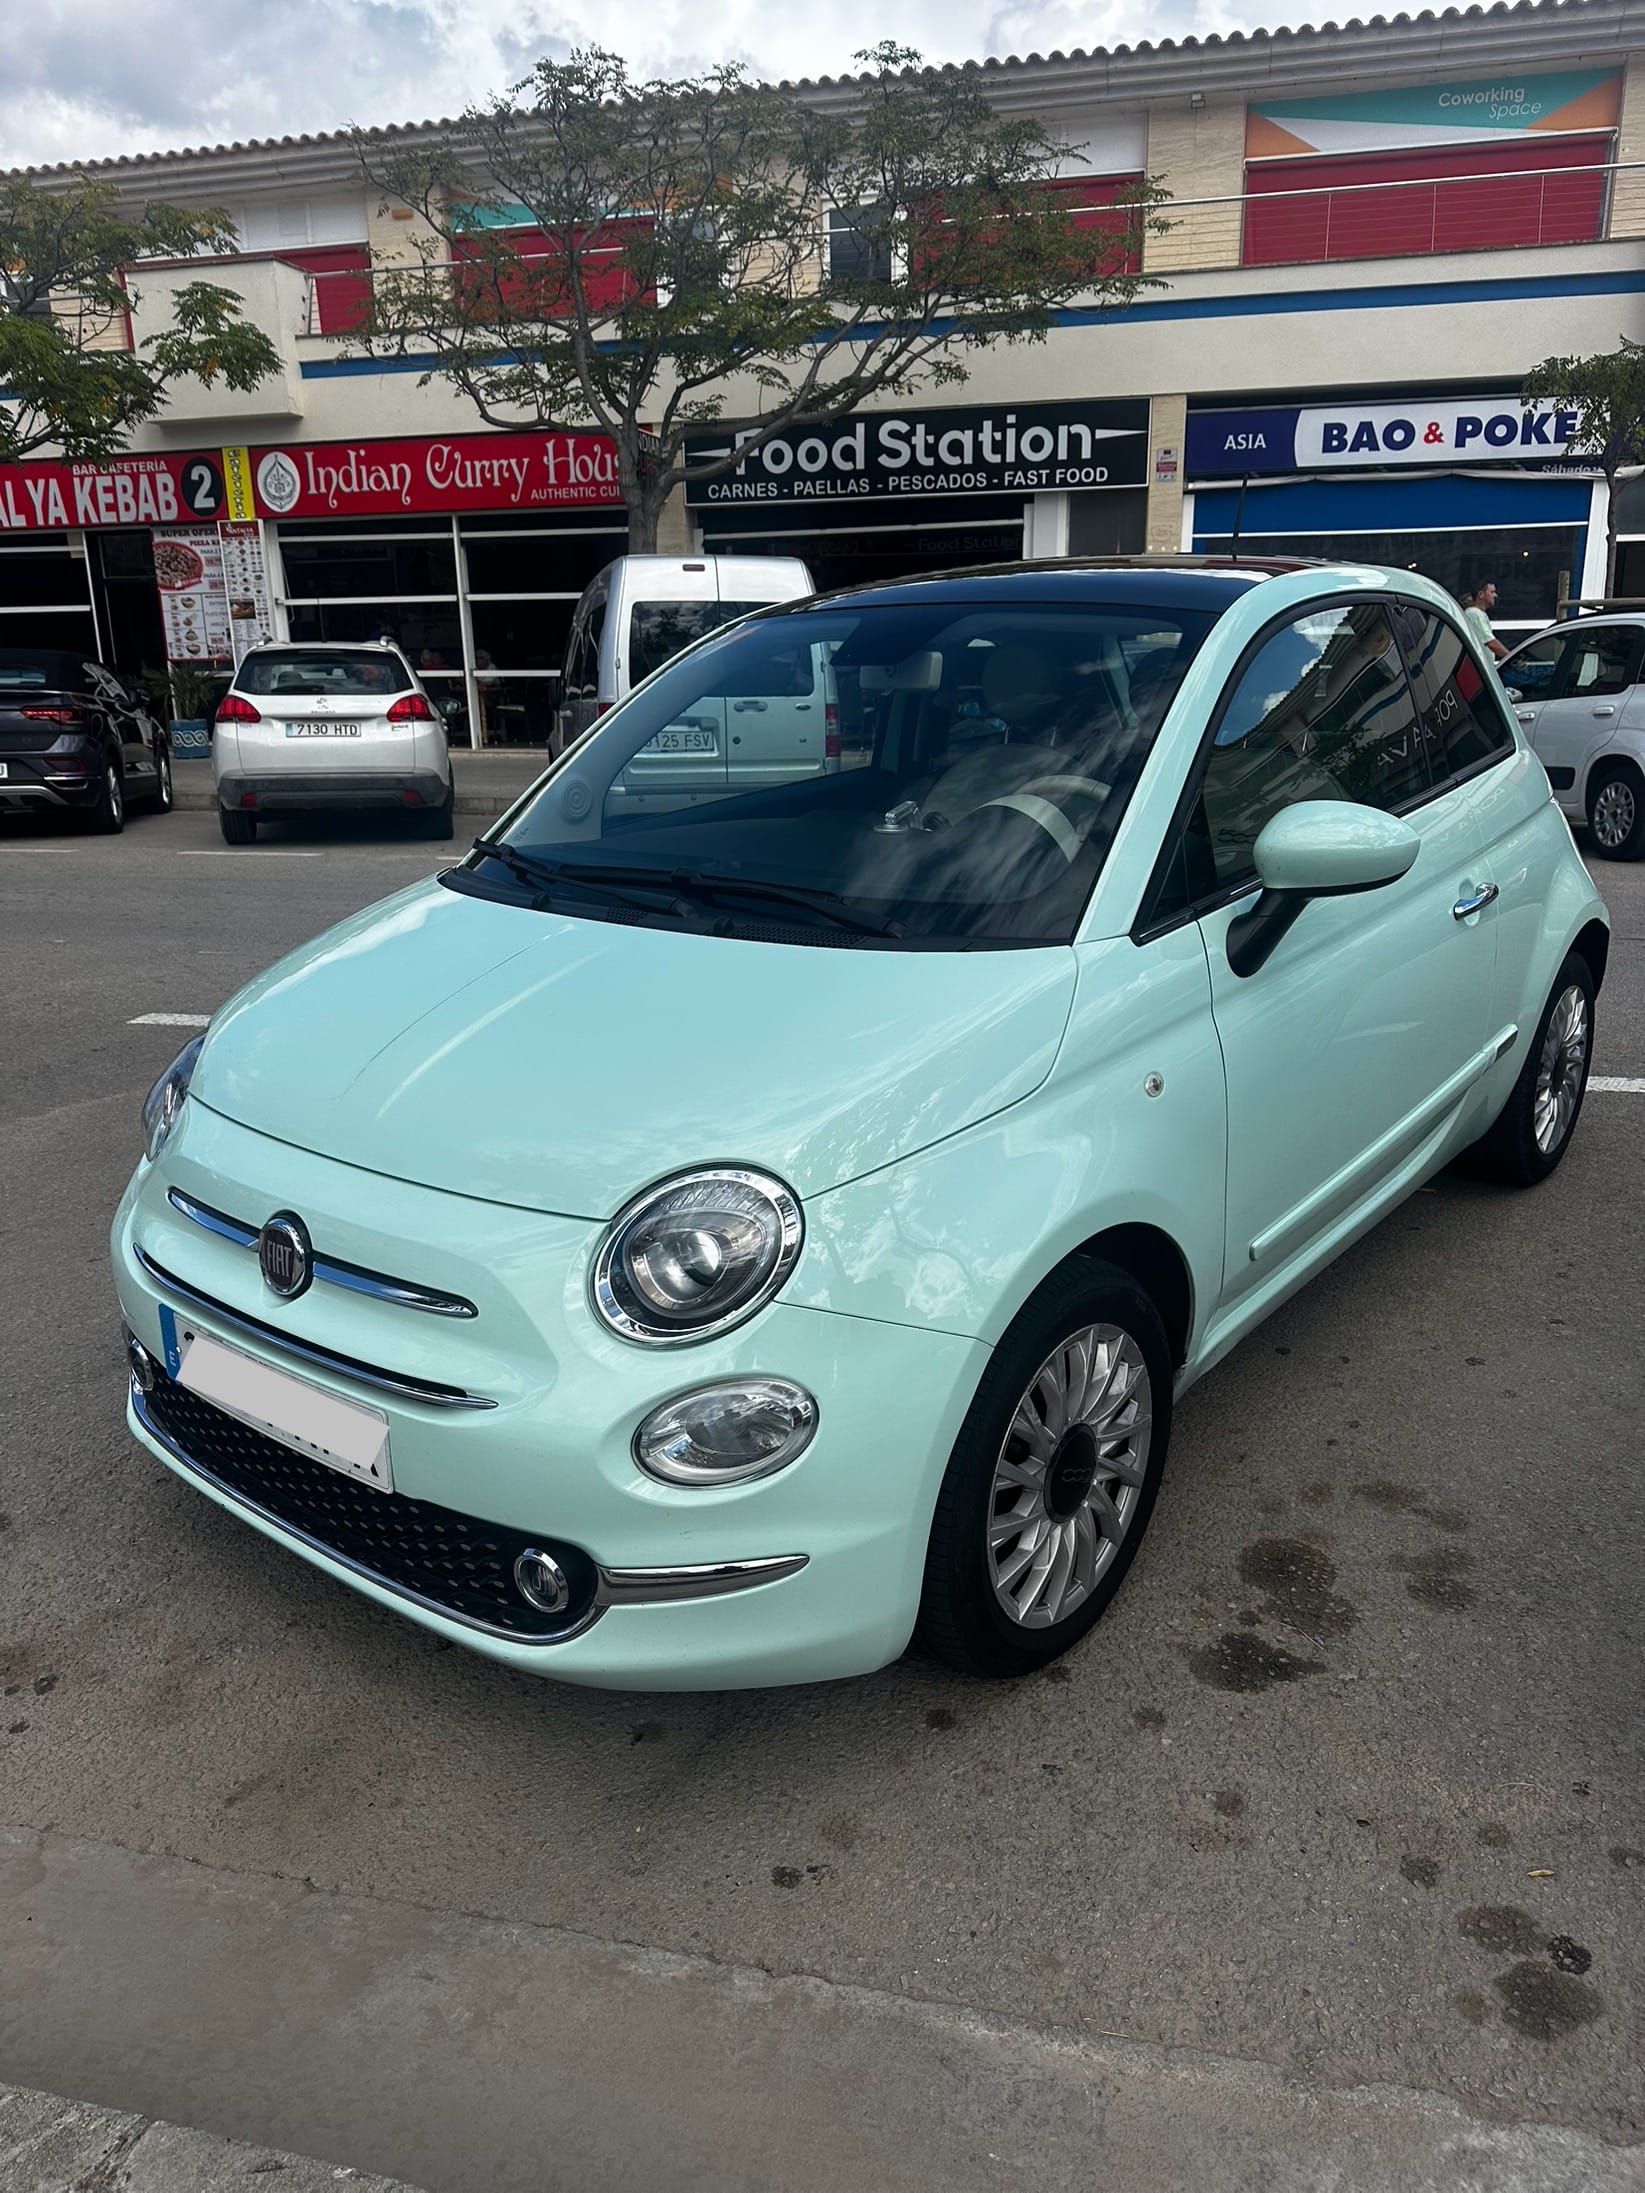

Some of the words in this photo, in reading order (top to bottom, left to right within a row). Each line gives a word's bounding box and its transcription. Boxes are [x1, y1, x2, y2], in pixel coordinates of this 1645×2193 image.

[1438, 86, 1525, 107] Coworking
[1488, 101, 1541, 120] Space
[1223, 433, 1267, 451] ASIA
[1321, 419, 1416, 454] BAO
[1422, 422, 1444, 445] &
[1454, 410, 1579, 449] POKE
[735, 421, 865, 476] Food
[877, 413, 1093, 469] Station
[72, 463, 97, 476] BAR
[305, 449, 412, 509] Indian
[425, 443, 529, 503] Curry
[707, 482, 778, 499] CARNES
[793, 477, 870, 496] PAELLAS
[888, 473, 987, 492] PESCADOS
[1004, 469, 1050, 486] FAST
[1055, 466, 1109, 484] FOOD
[72, 472, 179, 525] KEBAB
[190, 464, 216, 509] 2
[530, 485, 597, 501] AUTHENTIC
[161, 528, 190, 537] SUPER
[297, 724, 328, 735] 7130
[334, 724, 358, 735] HTD
[684, 734, 711, 747] FSV
[266, 1238, 294, 1278] FIAT
